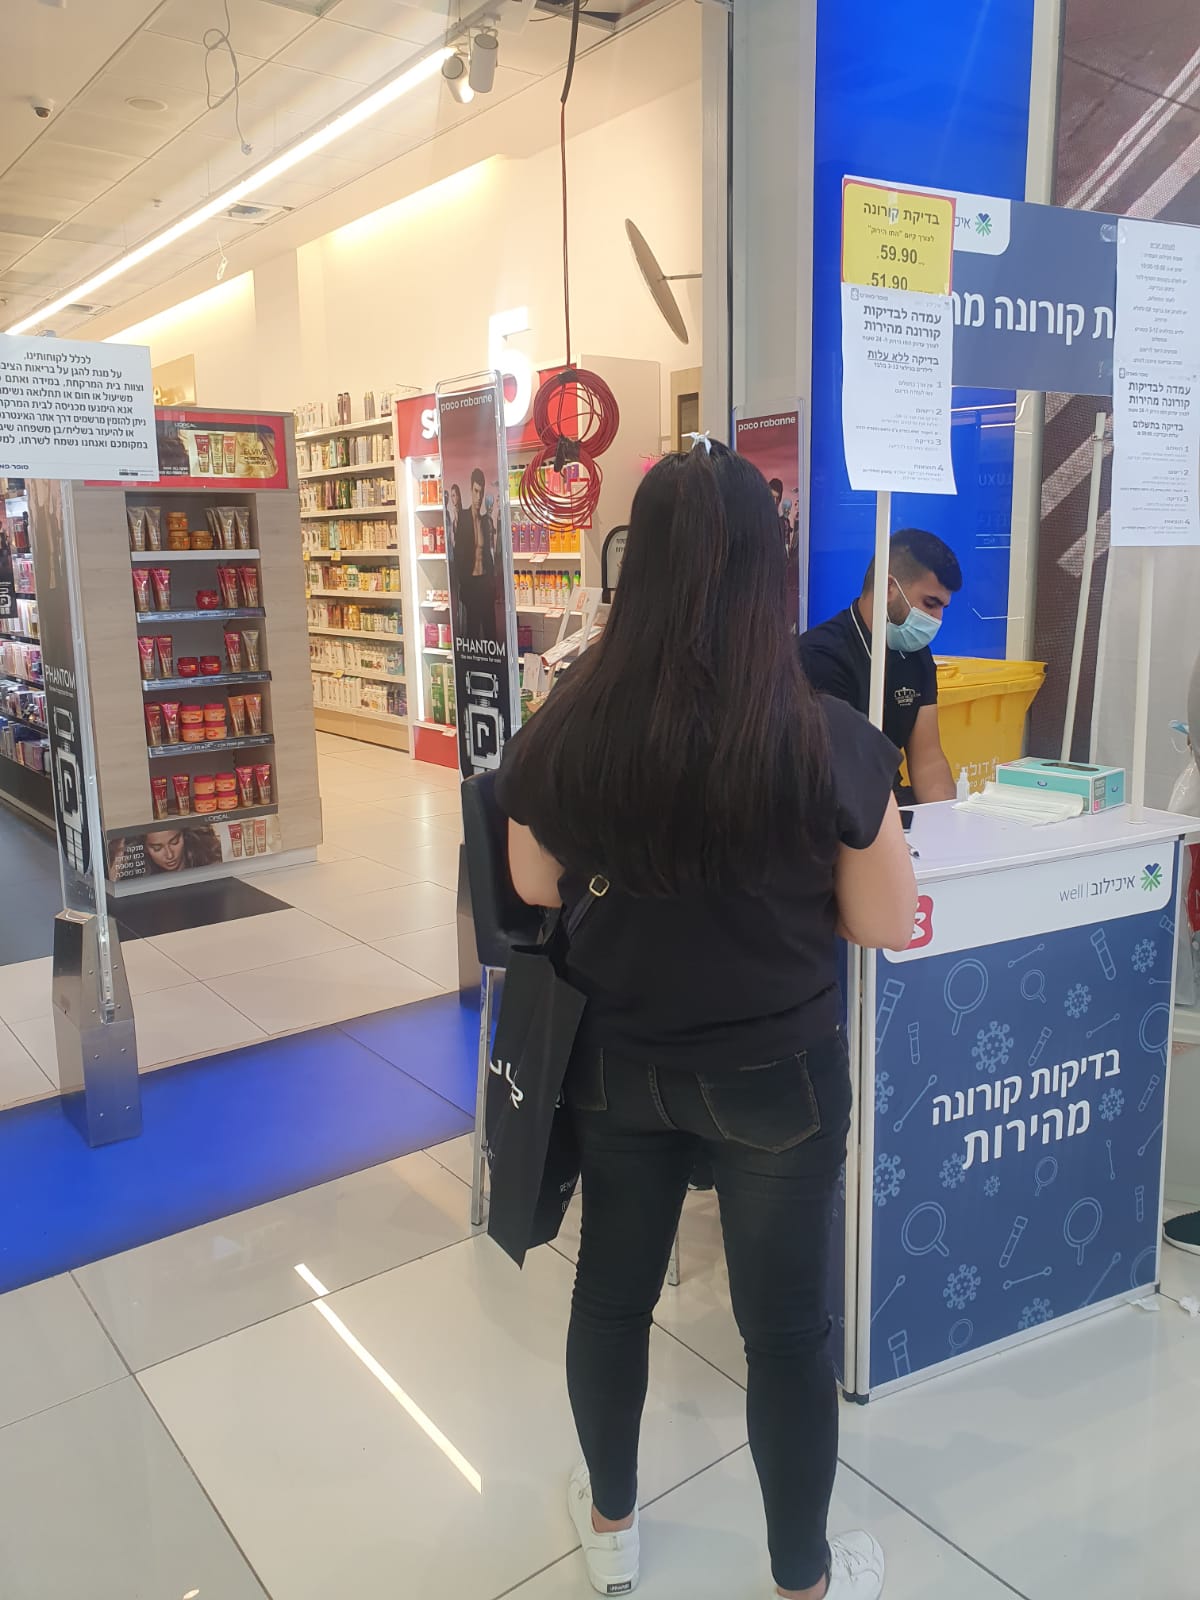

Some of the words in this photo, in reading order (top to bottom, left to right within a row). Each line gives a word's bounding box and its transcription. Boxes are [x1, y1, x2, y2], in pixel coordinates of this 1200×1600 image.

[863, 202, 899, 223] קורונה
[903, 209, 940, 225] בדיקת
[880, 244, 918, 264] 59.90
[871, 272, 908, 291] 51.90
[863, 305, 908, 320] לבדיקות
[911, 311, 942, 325] עמדה
[994, 295, 1085, 346] קורונה
[863, 319, 903, 336] מהירות
[905, 325, 941, 342] קורונה
[69, 354, 92, 365] לכלל
[867, 349, 889, 361] עלות
[891, 351, 910, 362] ללא
[911, 355, 940, 366] בדיקה
[25, 364, 55, 374] בריאות
[56, 365, 69, 375] על
[71, 366, 90, 378] להגן
[92, 369, 109, 378] מנת
[110, 369, 122, 379] על
[5, 374, 29, 385] ואתם
[32, 376, 60, 386] במידה
[106, 383, 121, 391] בית
[124, 383, 145, 392] וצוות
[1128, 381, 1164, 393] לבדיקות
[1166, 385, 1192, 396] עמדה
[26, 388, 61, 398] תחלואה
[63, 391, 73, 399] או
[75, 391, 90, 400] חום
[93, 393, 102, 401] או
[103, 392, 133, 403] משיעול
[31, 400, 53, 410] לבית
[440, 401, 460, 413] paco
[460, 393, 493, 408] rabanne
[1128, 394, 1159, 406] מהירות
[1161, 397, 1191, 411] קורונה
[55, 402, 86, 411] מכניסה
[88, 404, 115, 413] הימנעו
[117, 406, 133, 414] אנא
[0, 412, 35, 421] האינטרנ
[36, 413, 55, 422] אתר
[56, 414, 71, 425] דרך
[73, 415, 105, 424] מרשמים
[106, 416, 131, 426] להזמין
[132, 418, 147, 428] ניתן
[738, 421, 759, 433] paco
[759, 415, 796, 429] rabanne
[1132, 420, 1160, 430] בתשלום
[1161, 423, 1184, 432] בדיקה
[16, 424, 52, 434] משפחה
[53, 425, 94, 436] בשליח/בן
[95, 427, 124, 437] להיעזר
[126, 429, 134, 437] או
[53, 438, 79, 447] נשמח
[81, 439, 108, 448] ואנחנו
[110, 440, 148, 451] במקומכם
[455, 637, 506, 657] PHANTOM
[44, 664, 77, 690] PHANTOM
[1090, 875, 1136, 898] איכילוב
[1059, 884, 1084, 904] well
[1029, 1048, 1121, 1099] בדיקות
[932, 1075, 1023, 1126] קורונה
[962, 1099, 1090, 1171] מהירות
